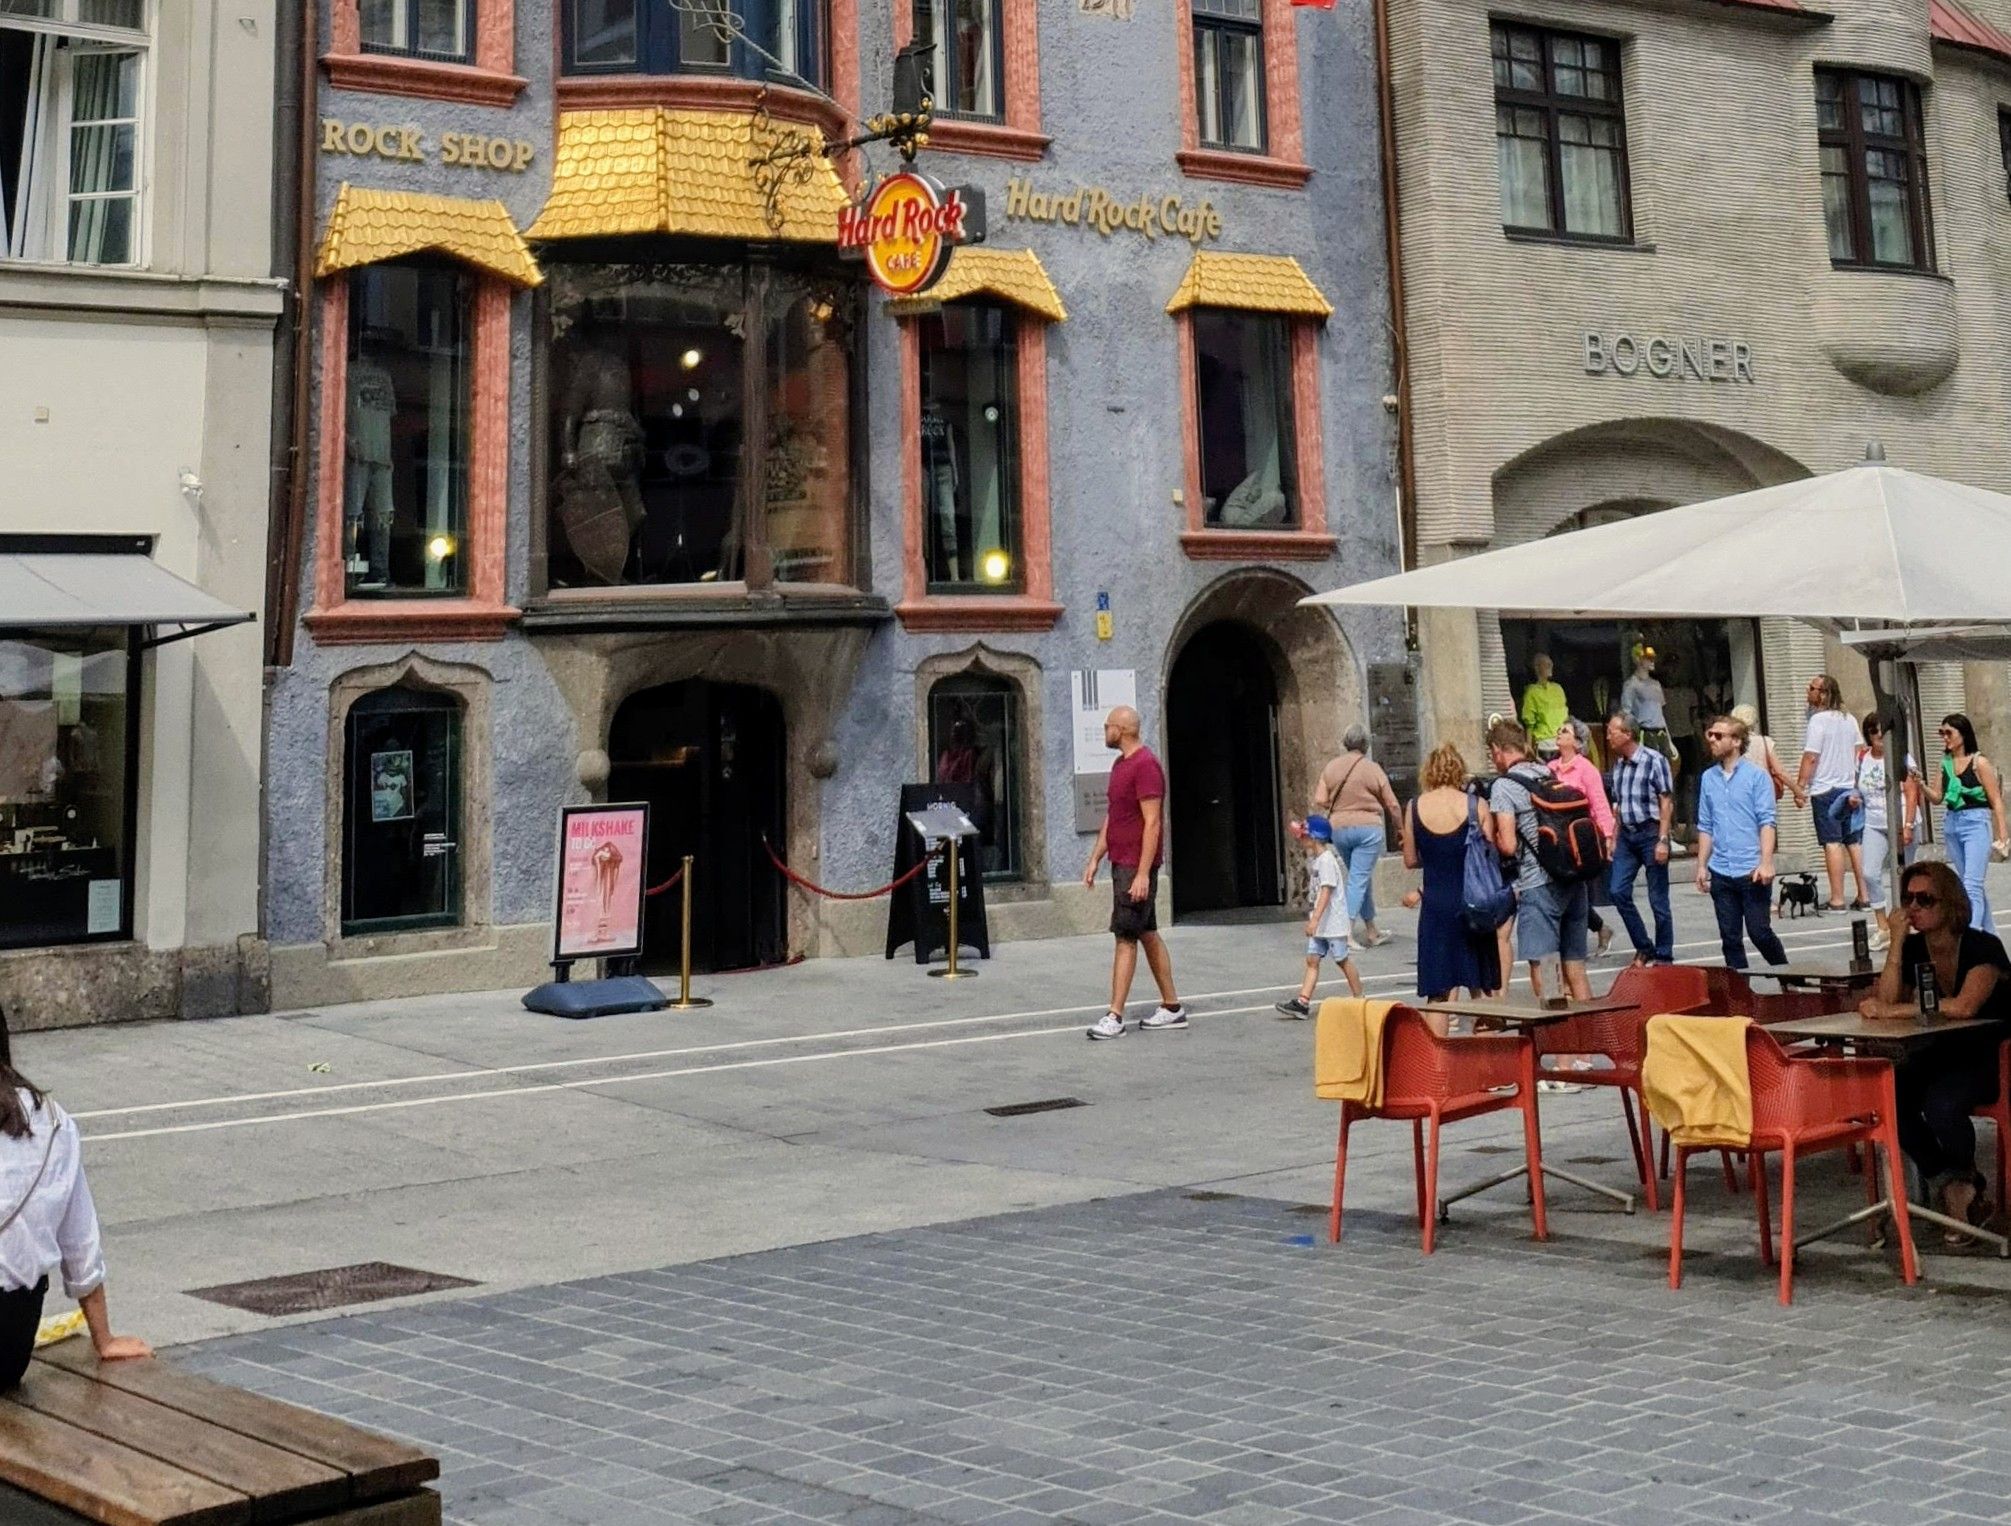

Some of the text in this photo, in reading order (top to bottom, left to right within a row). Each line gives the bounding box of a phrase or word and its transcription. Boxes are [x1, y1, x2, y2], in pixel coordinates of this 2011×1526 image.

[321, 118, 535, 170] ROCK SHOP
[837, 190, 967, 247] Hard Rock
[1007, 176, 1223, 243] Hard Rock Cafe
[886, 251, 922, 271] CAFE
[1584, 331, 1754, 384] BOGNER
[571, 819, 635, 838] MILKSHAKE
